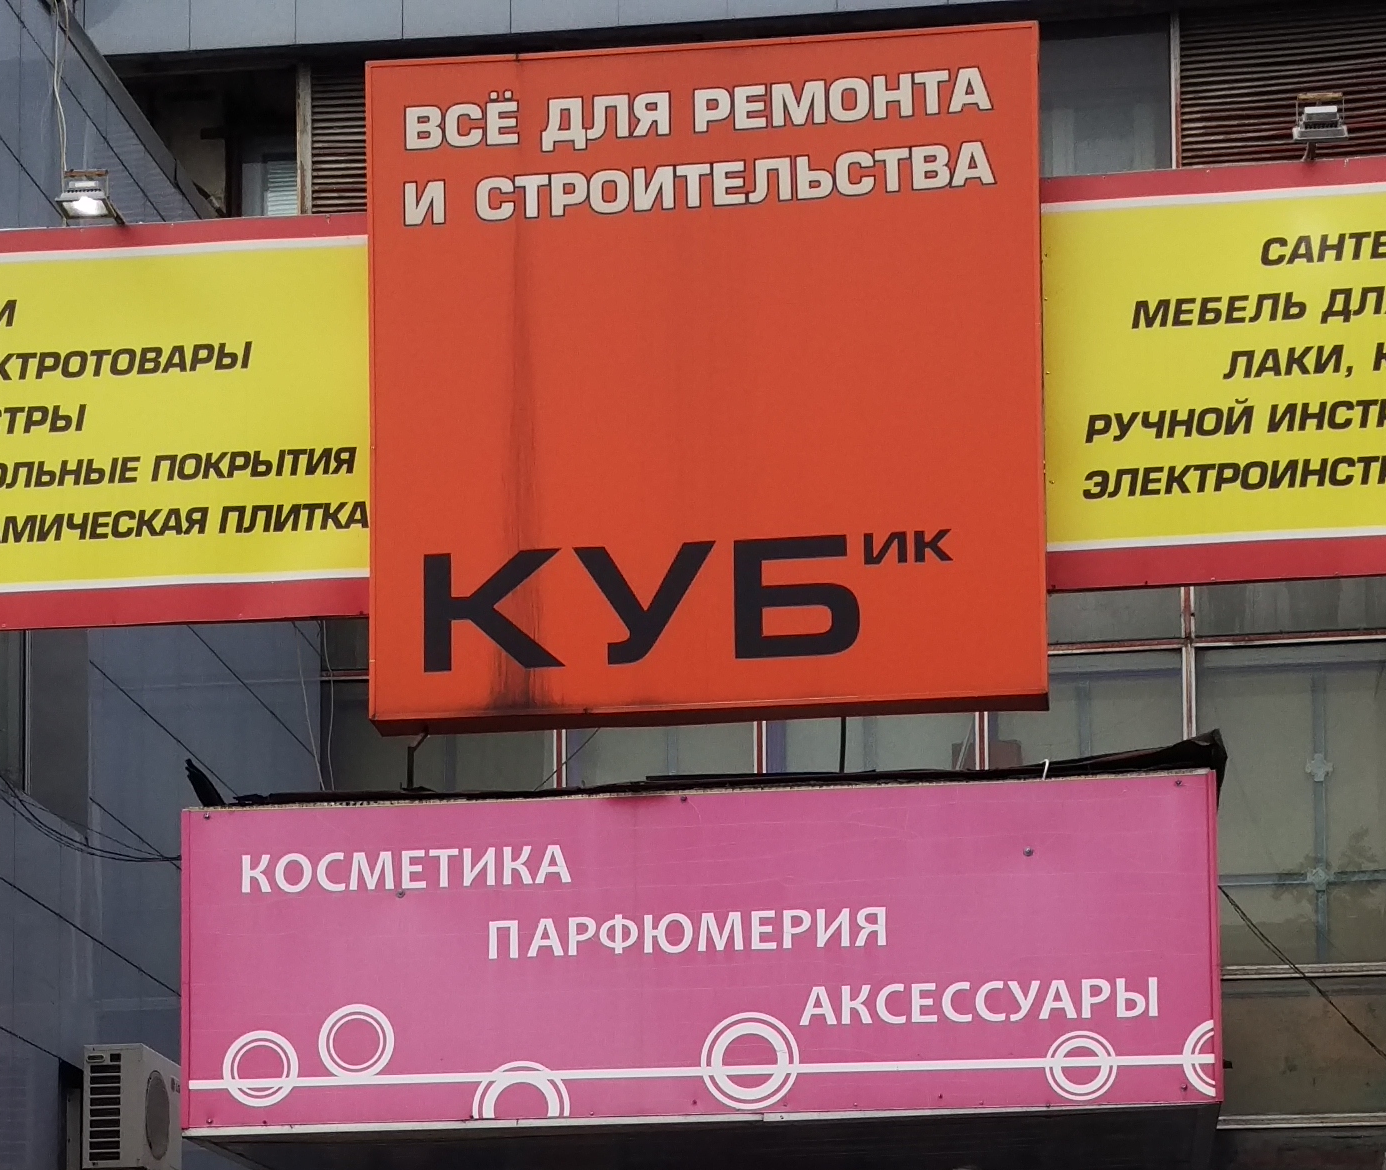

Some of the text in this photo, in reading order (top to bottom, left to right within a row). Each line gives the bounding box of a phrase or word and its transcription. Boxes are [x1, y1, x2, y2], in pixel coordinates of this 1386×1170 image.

[404, 66, 993, 153] ВСЁ ДЛЯ РЕМОНТА
[403, 141, 996, 227] И СТРОИТЕЛЬСТВА
[1131, 291, 1307, 330] МЕБЕЛЬ
[1222, 344, 1355, 380] ЛАКИ,
[1084, 399, 1254, 444] РУЧНОЙ
[151, 446, 357, 482] ПОКРЫТИЯ
[218, 500, 369, 536] ПЛИТКА
[241, 844, 572, 894] КОСМЕТИКА
[487, 906, 888, 960] ПАРФЮМЕРИЯ
[799, 976, 1159, 1027] АКСЕССУАРЫ
